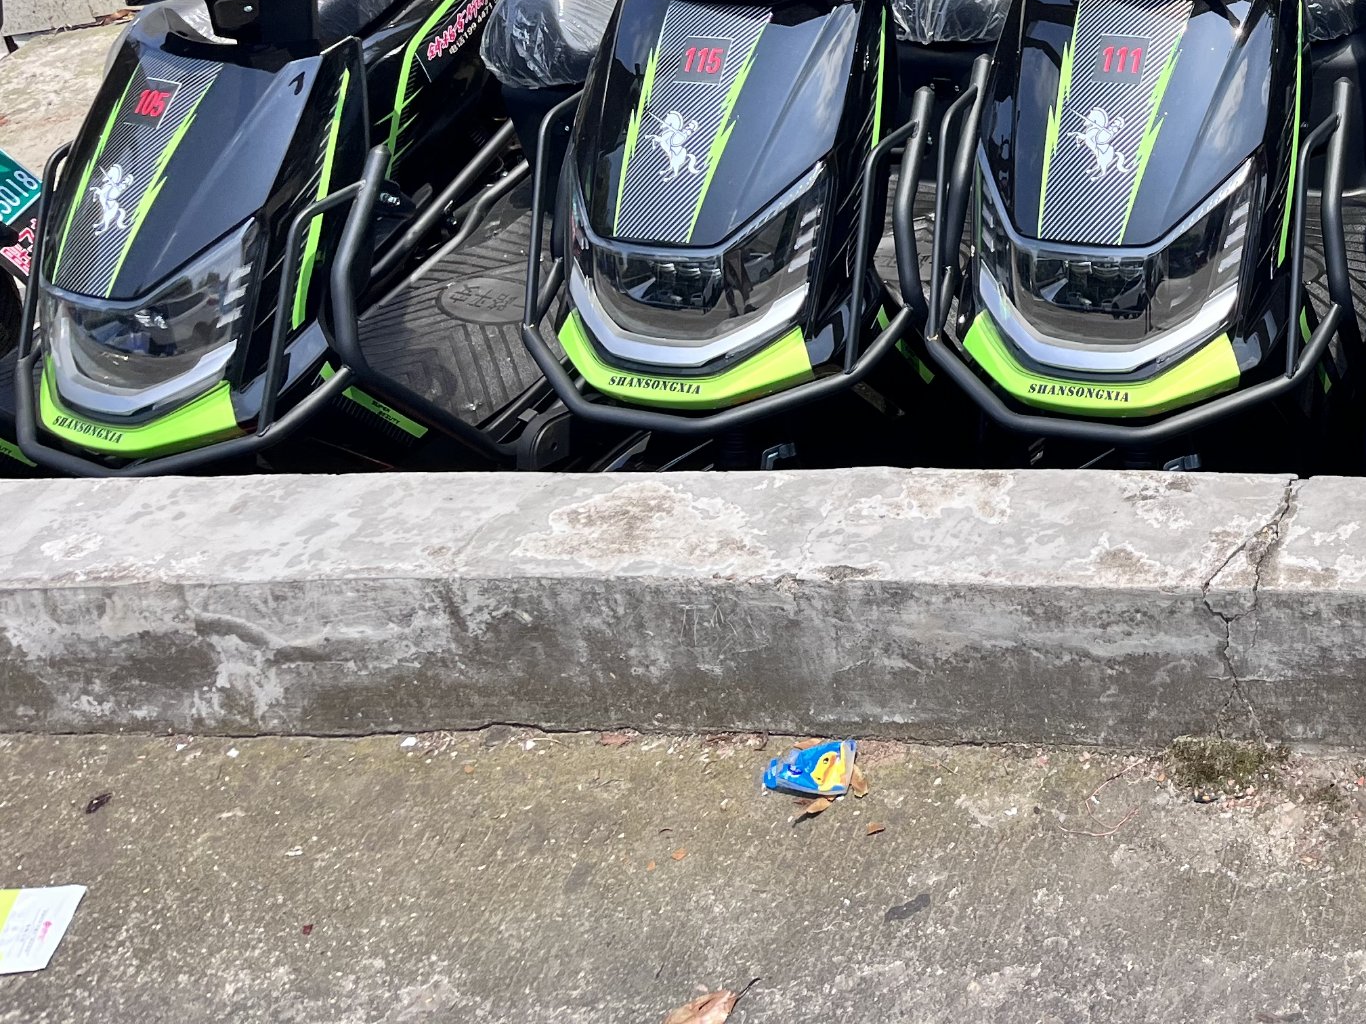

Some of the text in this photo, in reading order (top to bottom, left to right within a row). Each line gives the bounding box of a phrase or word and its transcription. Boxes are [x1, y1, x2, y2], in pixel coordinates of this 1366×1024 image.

[684, 47, 724, 74] 115
[1103, 46, 1143, 74] 111
[134, 89, 171, 117] 105
[609, 376, 701, 394] SHANSONGXIA
[1028, 383, 1130, 402] SHANSONGXIA
[52, 415, 124, 444] SHANSONGXIA
